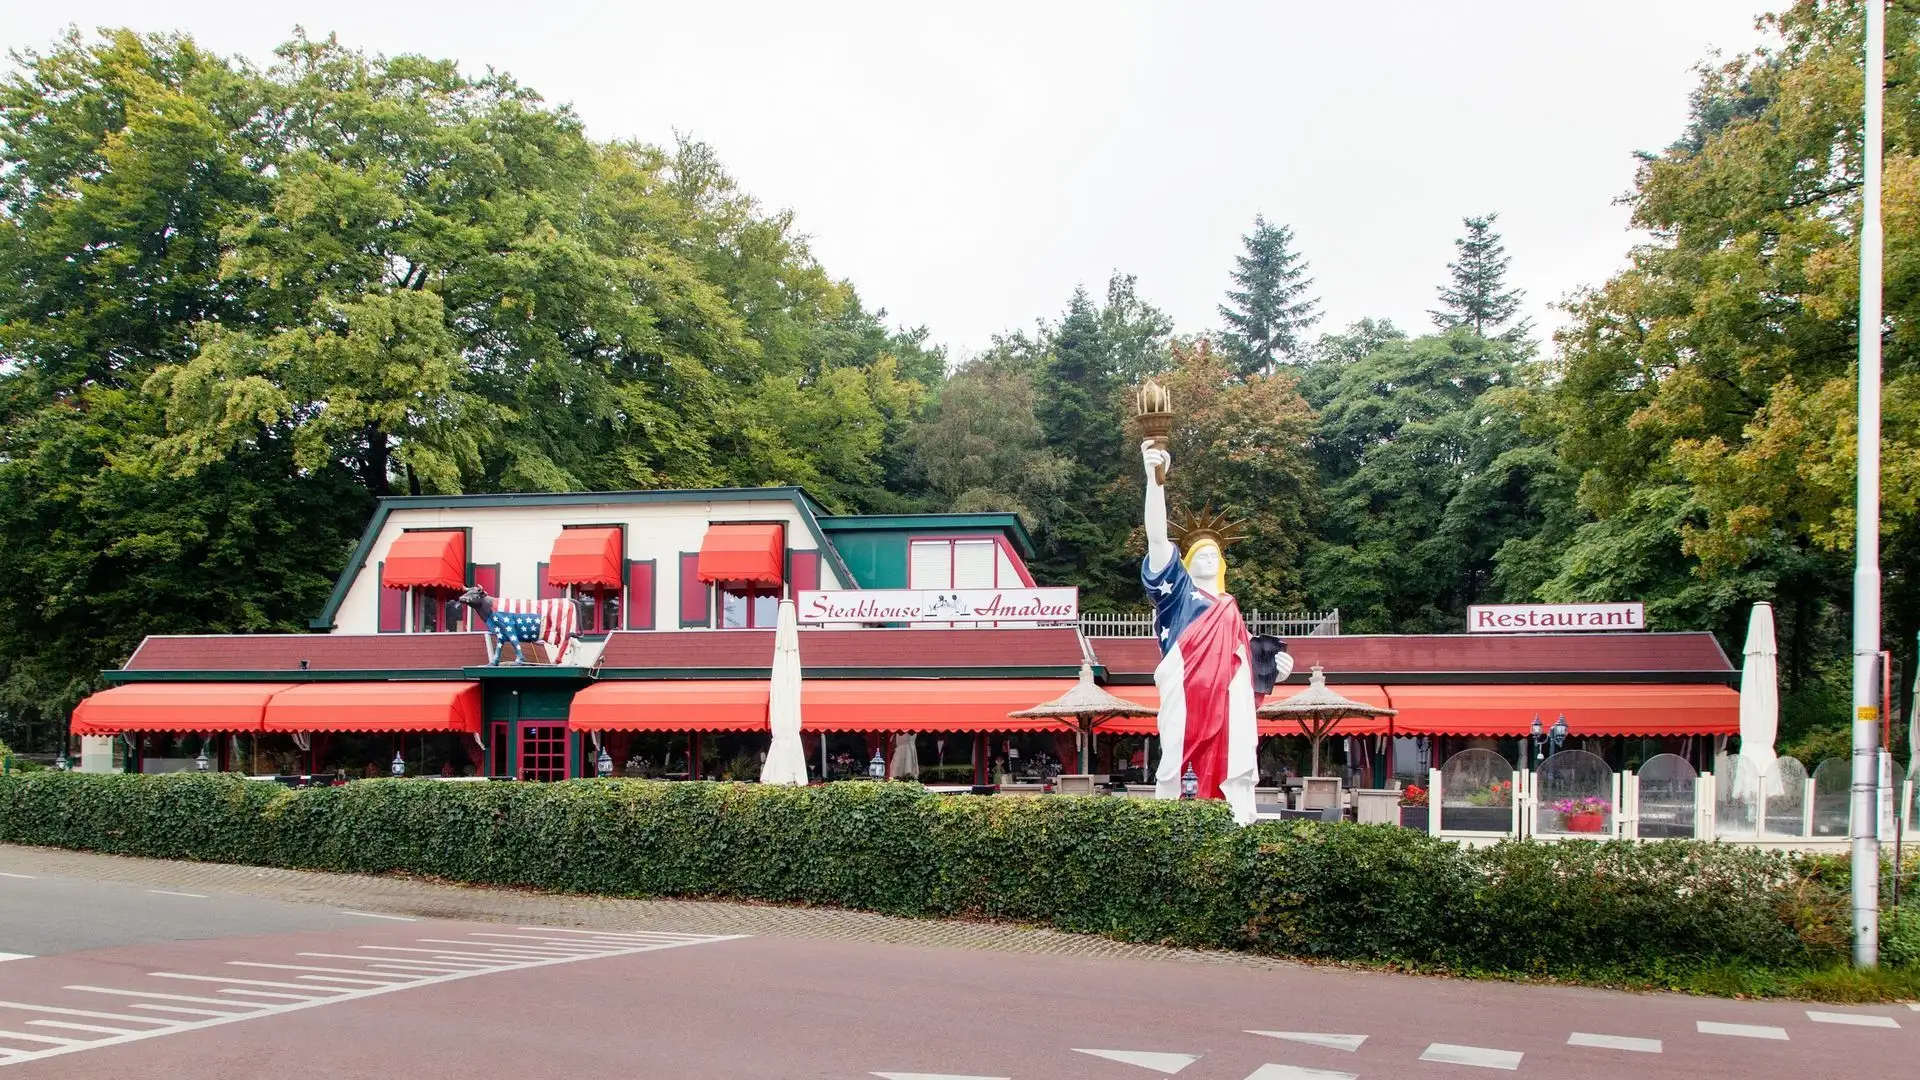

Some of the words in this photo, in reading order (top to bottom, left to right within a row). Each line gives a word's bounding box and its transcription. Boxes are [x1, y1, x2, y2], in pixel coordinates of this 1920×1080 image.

[804, 595, 920, 618] Steakhouse
[973, 593, 1072, 616] Amadeus
[1478, 608, 1636, 627] Restaurant
